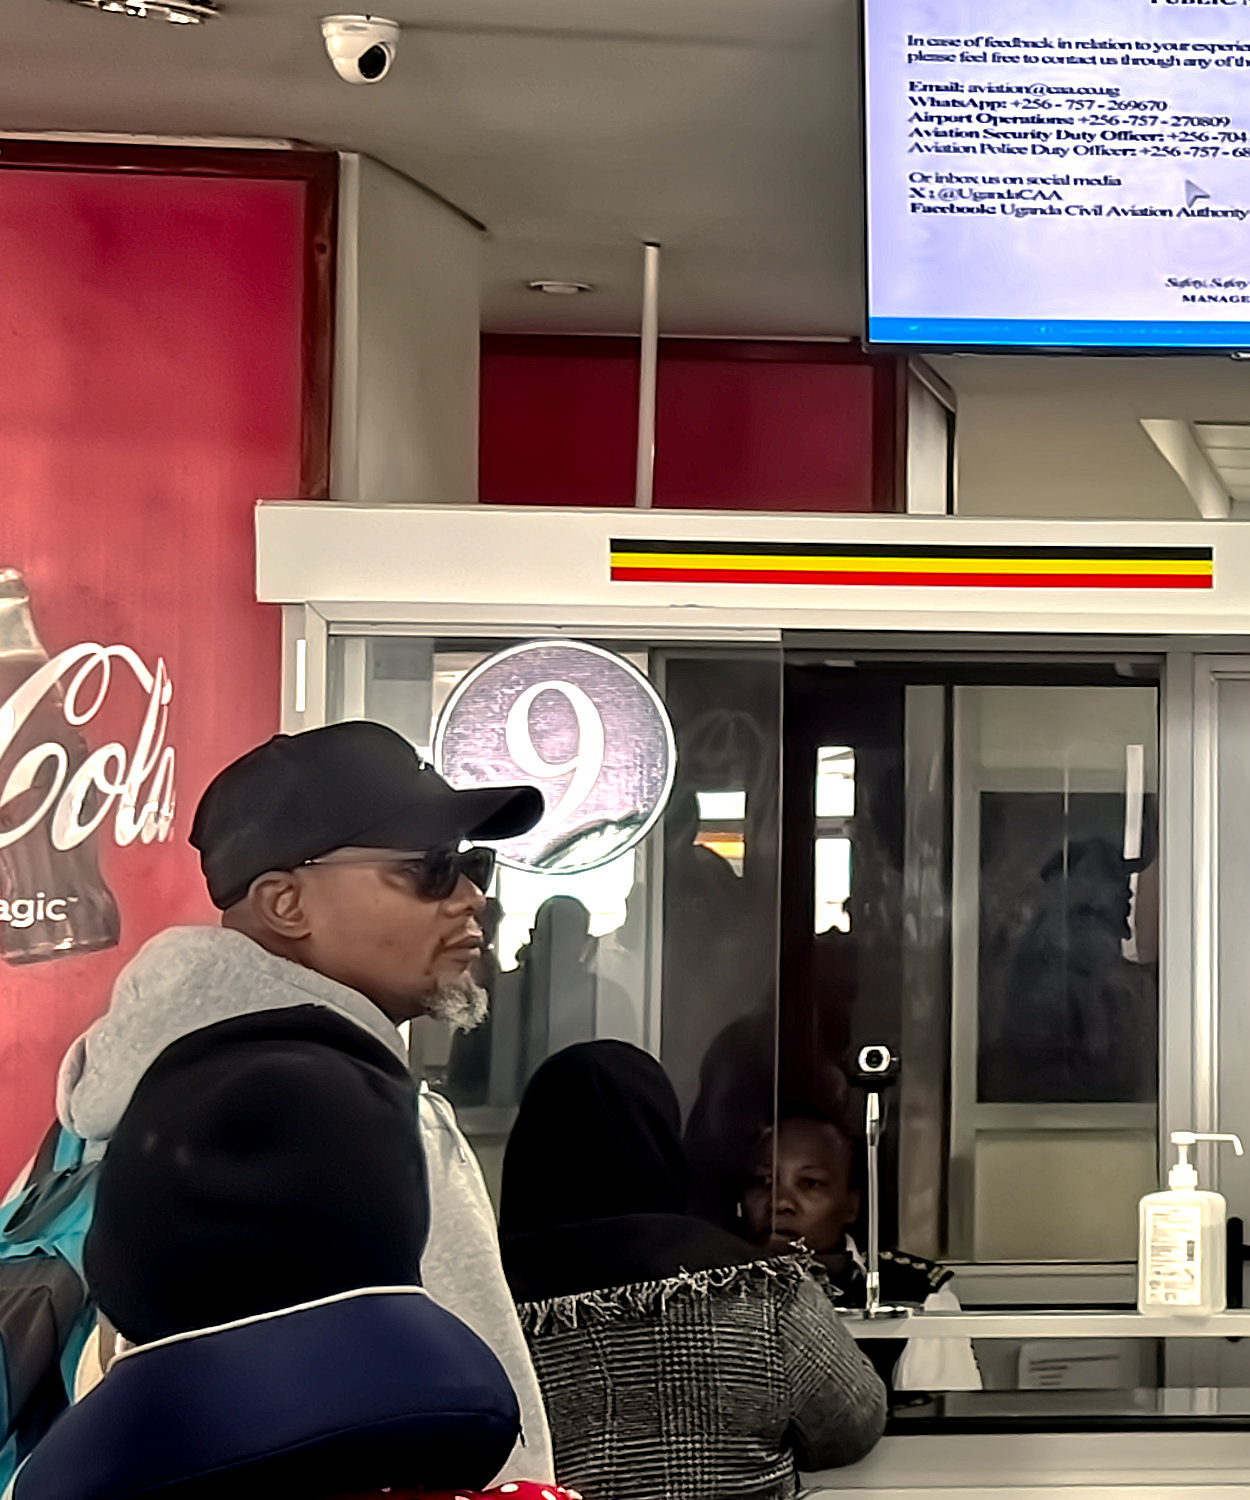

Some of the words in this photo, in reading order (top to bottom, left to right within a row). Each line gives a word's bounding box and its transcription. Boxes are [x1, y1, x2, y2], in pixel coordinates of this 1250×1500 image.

[908, 35, 923, 46] In
[927, 38, 960, 47] case
[964, 37, 982, 47] of
[985, 37, 1053, 48] feedback
[1057, 38, 1071, 50] in
[1075, 39, 1132, 51] relation
[1135, 42, 1151, 50] to
[1153, 43, 1190, 53] your
[908, 50, 956, 65] please
[960, 52, 986, 62] feel
[992, 53, 1020, 63] free
[1024, 55, 1038, 63] to
[1042, 55, 1096, 65] contact
[1122, 54, 1180, 68] through
[1184, 58, 1212, 69] any
[1215, 56, 1234, 67] of
[909, 96, 1007, 111] WhatsApp:
[909, 112, 971, 125] Airport
[976, 113, 1074, 128] Operations:
[909, 128, 979, 139] Aviation
[983, 129, 1052, 142] Security
[1056, 130, 1096, 143] Duty
[1100, 131, 1164, 143] Officer:
[909, 142, 976, 154] Aviation
[980, 143, 1028, 154] Police
[1032, 144, 1069, 158] Duty
[1073, 144, 1136, 156] Officer:
[909, 172, 932, 182] Or
[935, 172, 979, 184] inbox
[982, 176, 999, 184] us
[1027, 174, 1070, 186] social
[1073, 176, 1121, 185] media
[910, 188, 924, 198] X
[1001, 204, 1062, 218] Uganda
[1065, 204, 1102, 217] Civil
[1106, 206, 1173, 217] Aviation
[1176, 206, 1250, 220] Authority
[1210, 278, 1249, 290] Safety
[505, 680, 605, 838] 9
